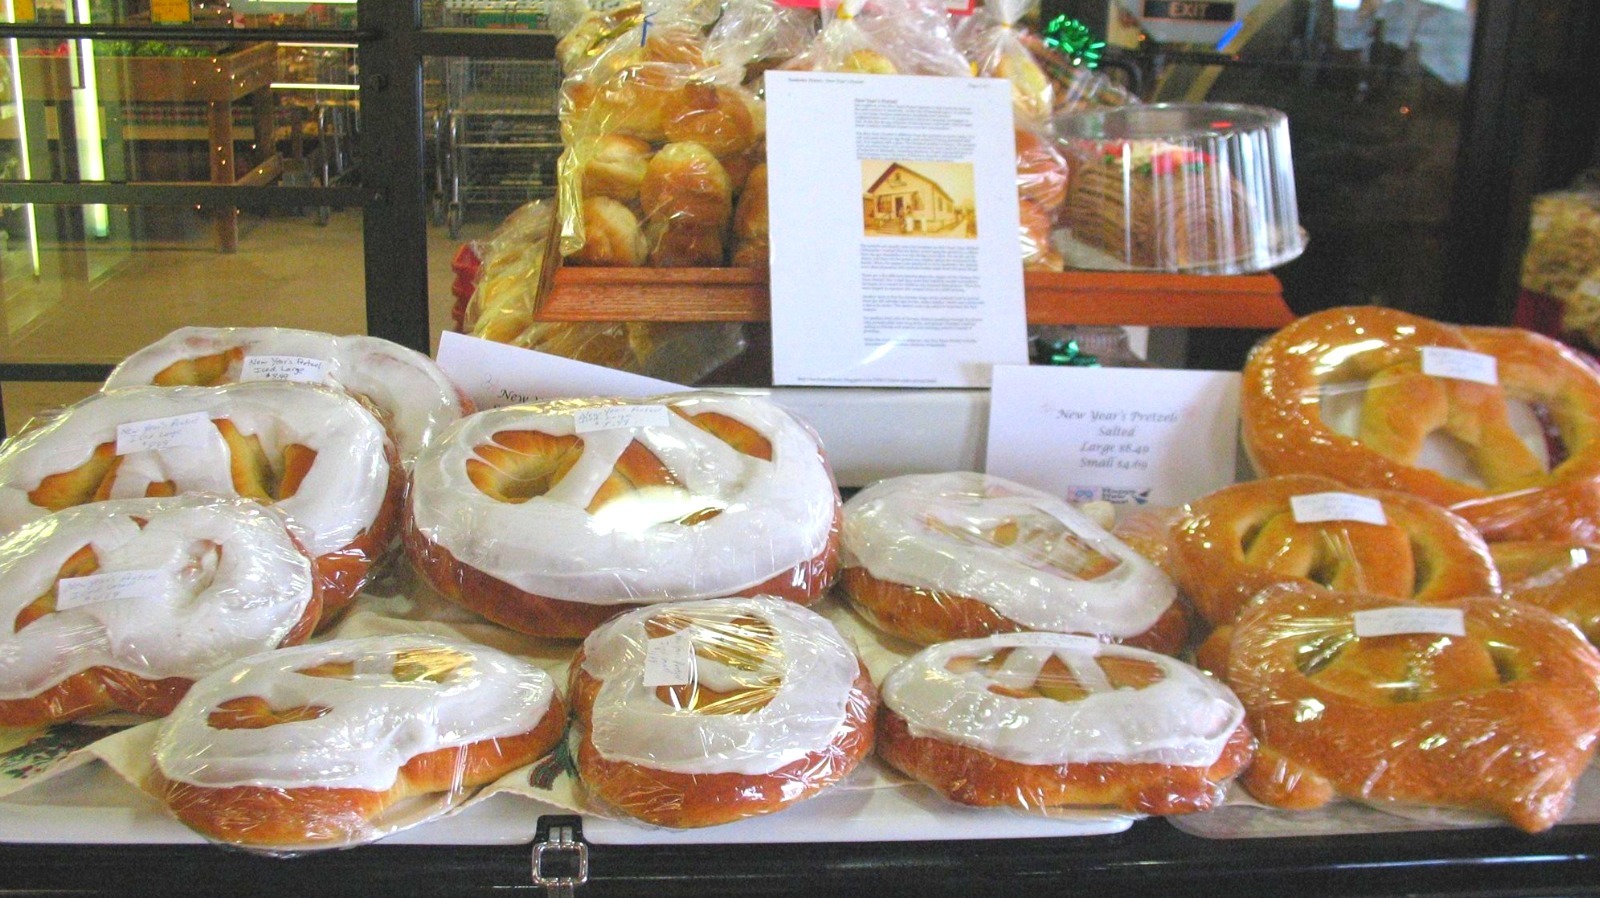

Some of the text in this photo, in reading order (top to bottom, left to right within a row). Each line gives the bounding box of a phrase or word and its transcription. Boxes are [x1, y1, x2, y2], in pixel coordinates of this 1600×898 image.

[1169, 1, 1208, 17] EXIT
[254, 366, 305, 375] Iced Large
[497, 389, 529, 403] New
[1056, 409, 1178, 422] New Year's Pretzels
[1098, 426, 1136, 437] Salted
[1080, 441, 1116, 455] Large
[1080, 457, 1117, 468] Small
